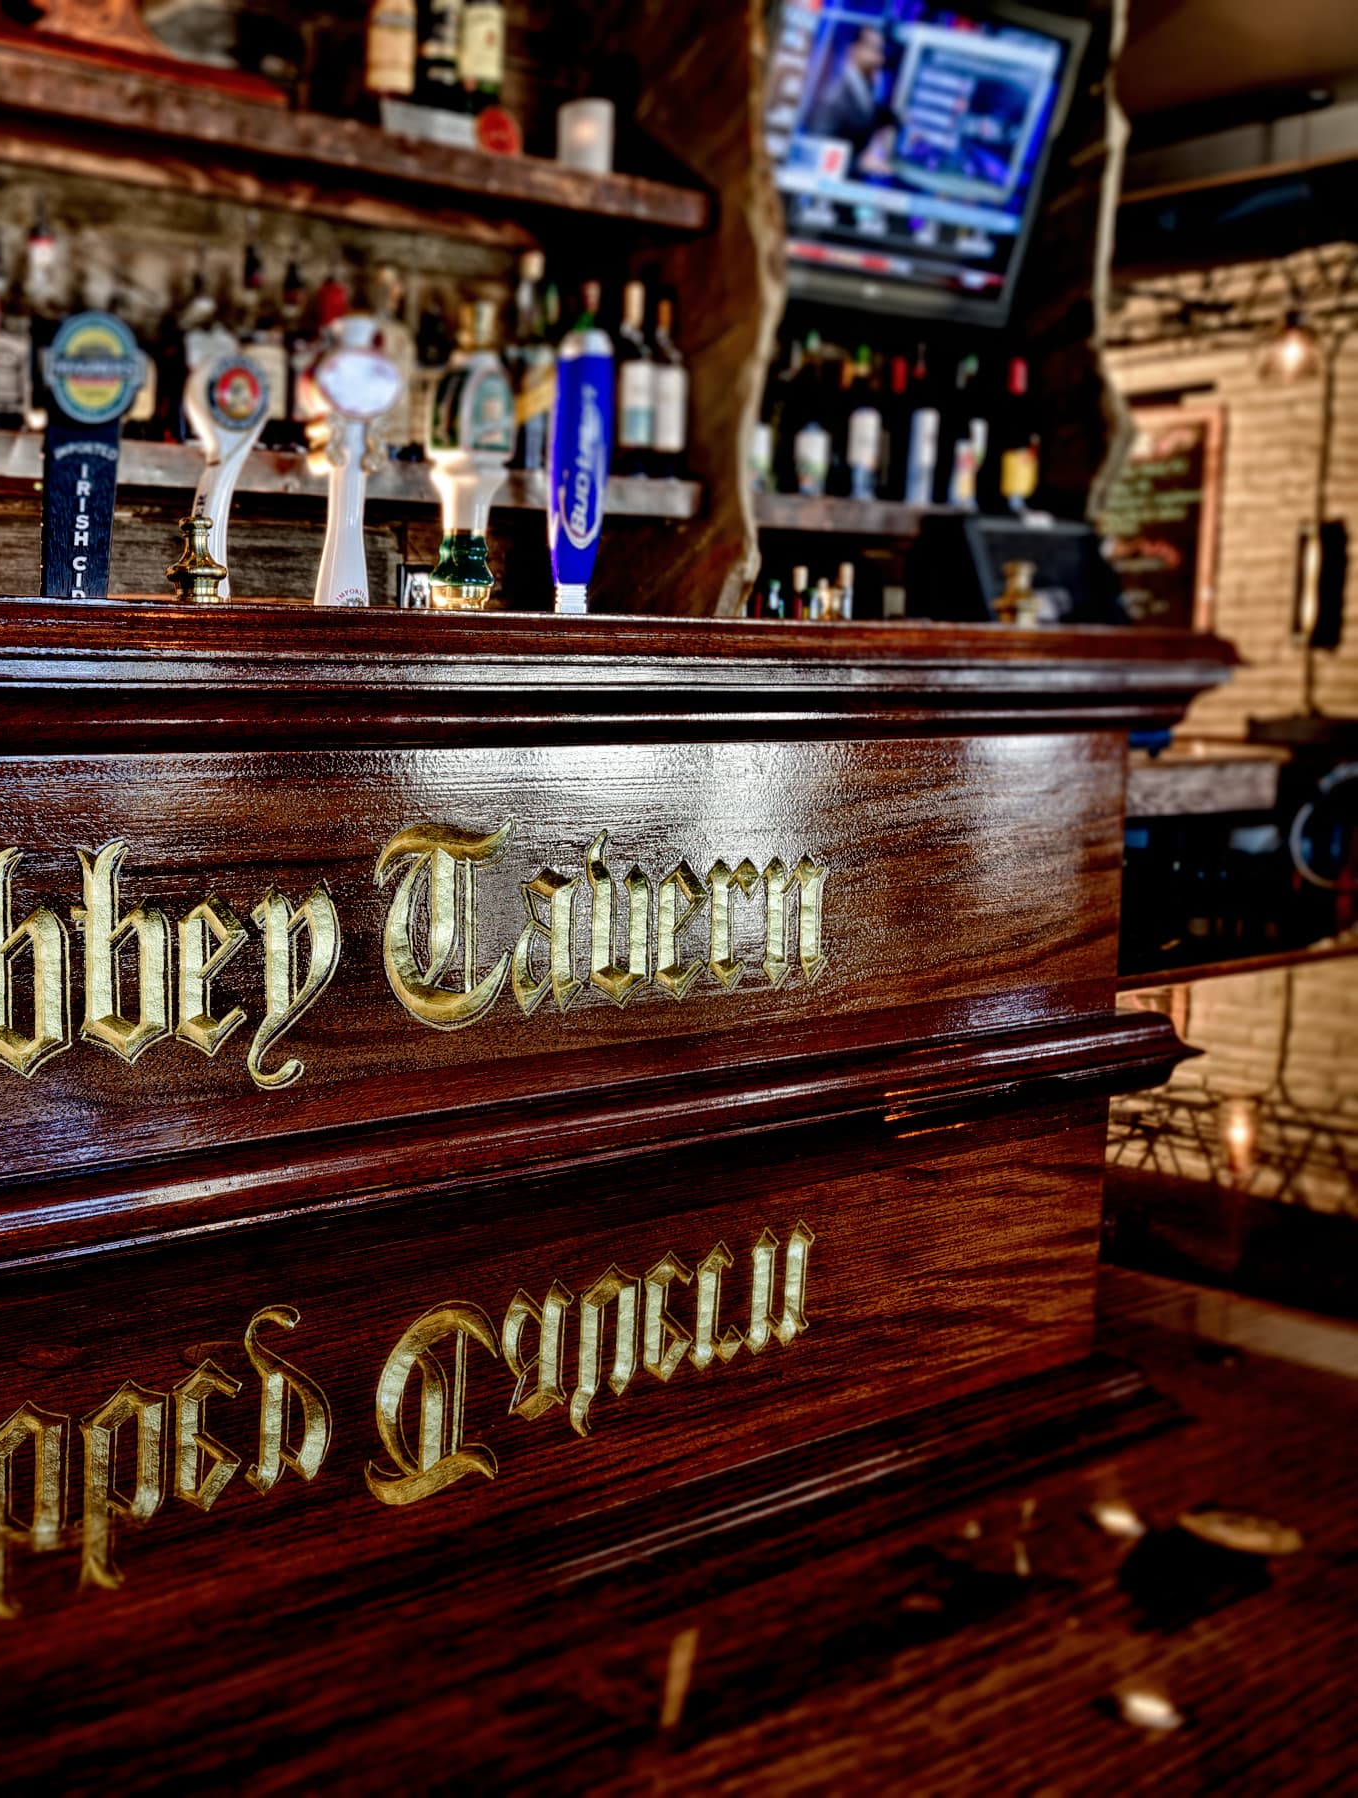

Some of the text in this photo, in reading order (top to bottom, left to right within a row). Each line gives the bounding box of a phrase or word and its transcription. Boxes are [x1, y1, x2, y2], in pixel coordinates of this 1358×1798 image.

[71, 463, 91, 599] IRISH CID
[373, 815, 829, 1033] Tavern
